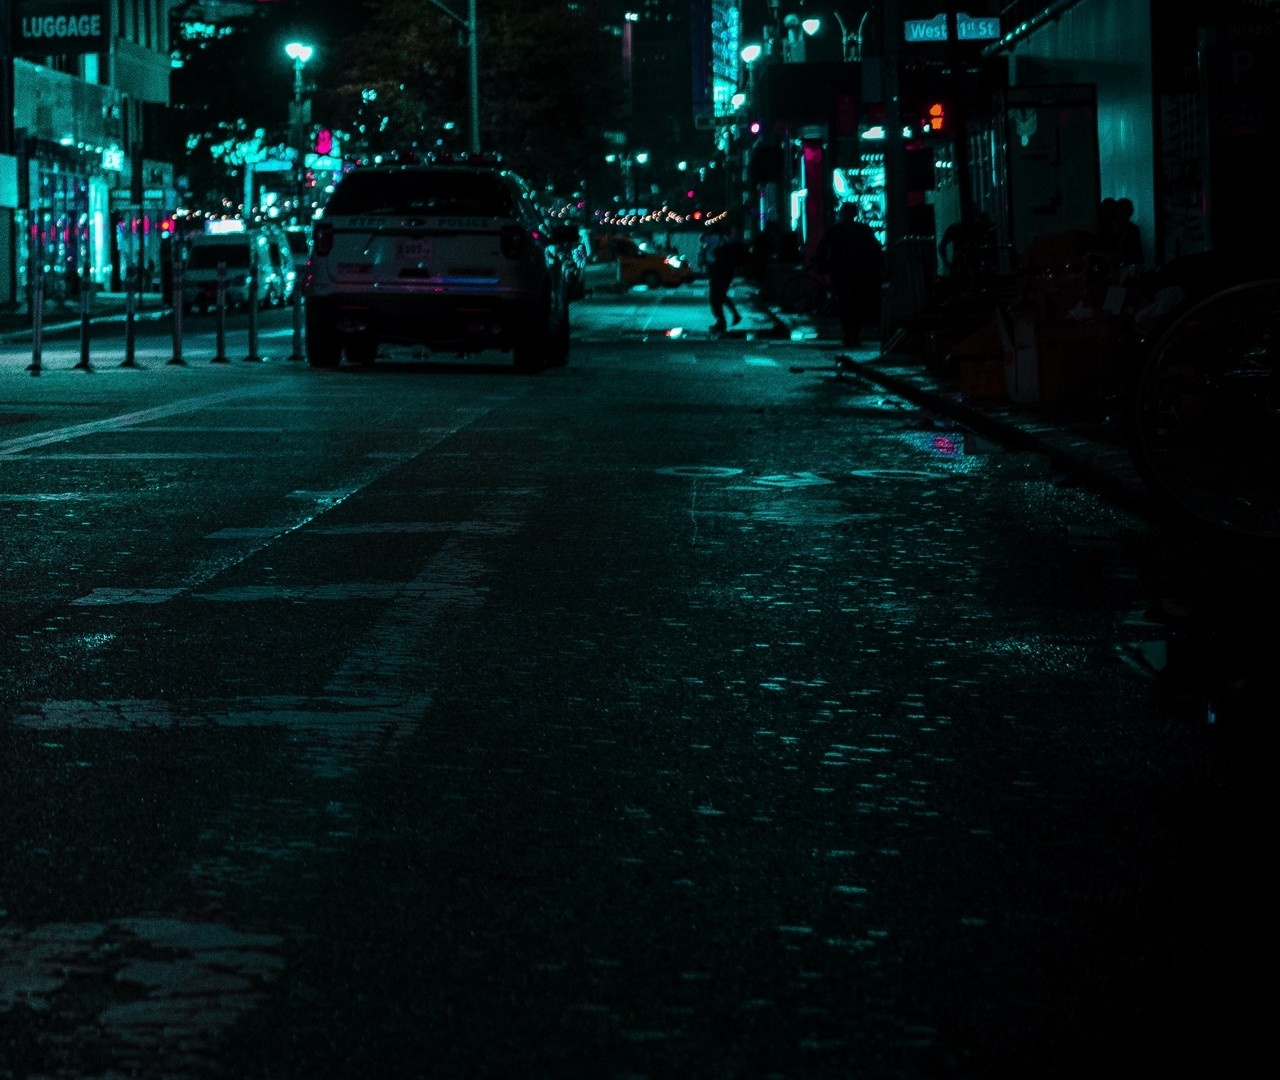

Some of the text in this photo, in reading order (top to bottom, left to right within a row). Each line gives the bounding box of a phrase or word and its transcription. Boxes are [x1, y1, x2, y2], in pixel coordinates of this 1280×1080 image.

[22, 14, 102, 39] LUGGAGE
[910, 22, 948, 39] West
[438, 217, 490, 228] POLICE
